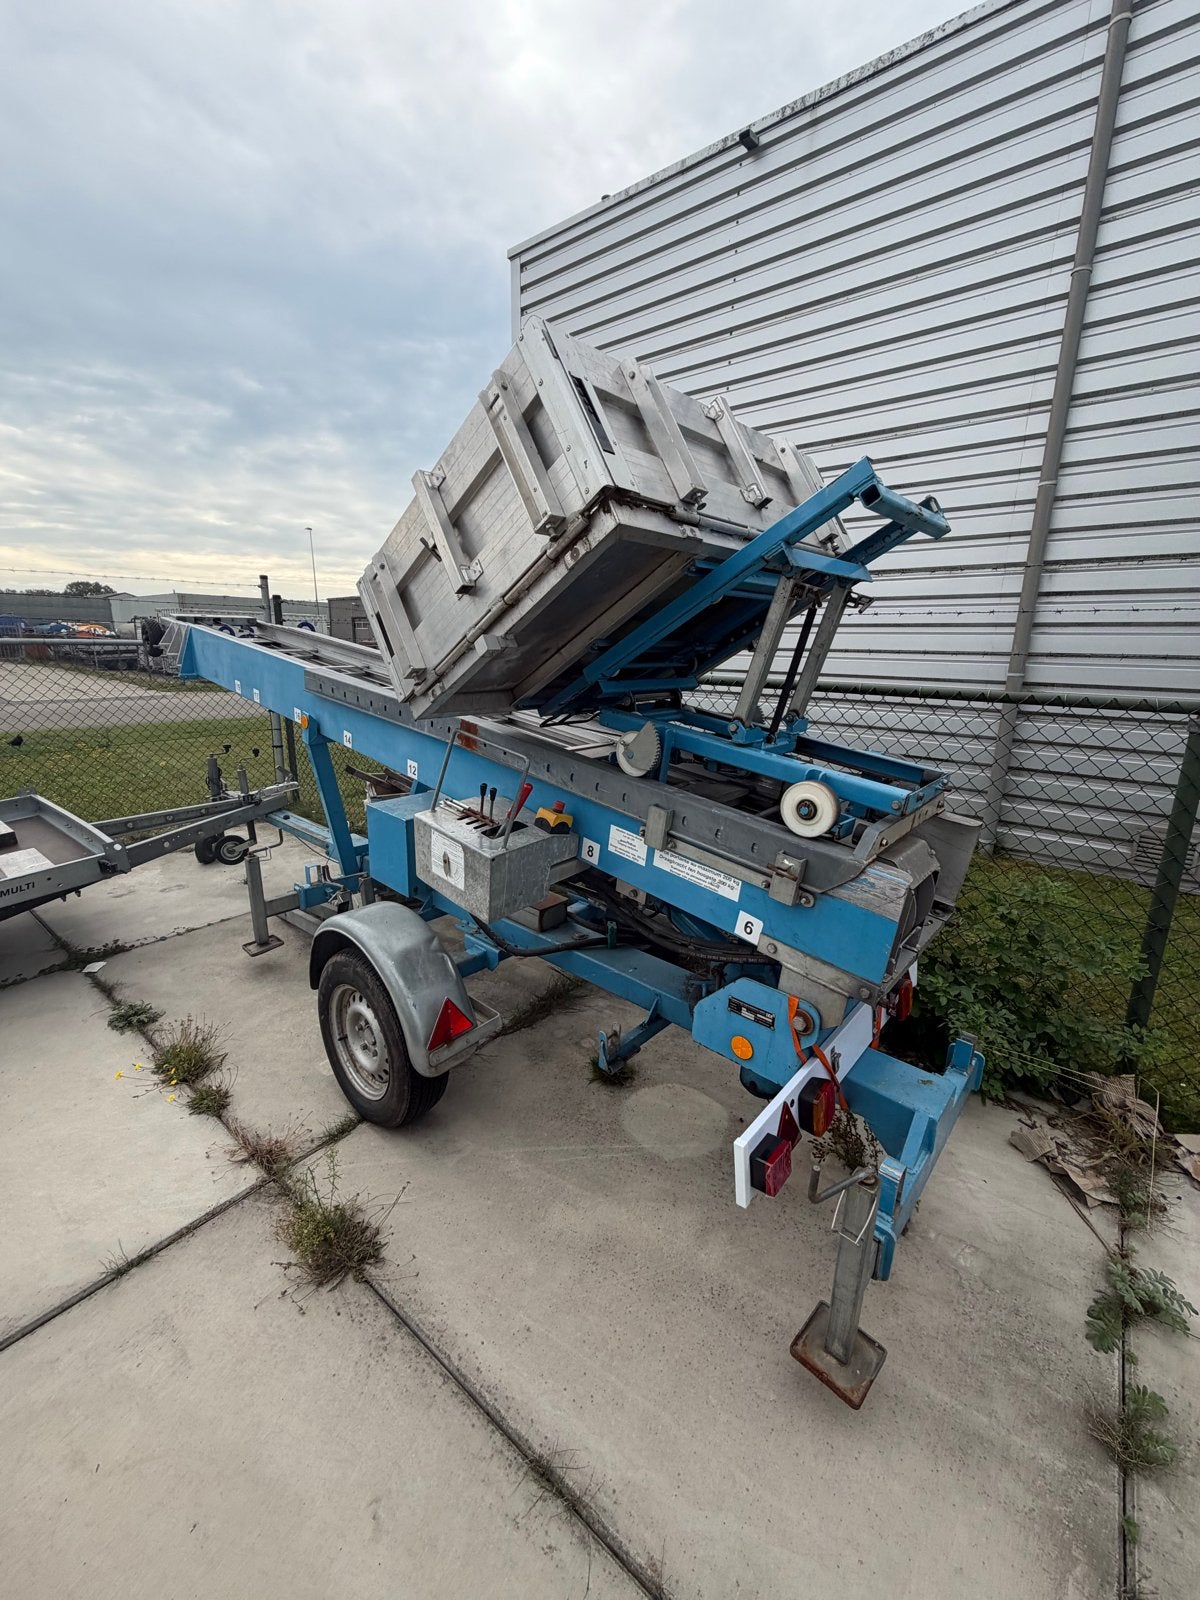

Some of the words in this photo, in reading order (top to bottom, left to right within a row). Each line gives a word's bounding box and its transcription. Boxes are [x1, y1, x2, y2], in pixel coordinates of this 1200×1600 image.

[344, 734, 351, 744] 14
[408, 764, 417, 776] 12
[587, 845, 594, 858] 8
[697, 864, 722, 878] maximum
[722, 874, 732, 883] 200
[0, 881, 35, 898] MULTI
[717, 879, 727, 887] 200
[744, 920, 754, 936] 6
